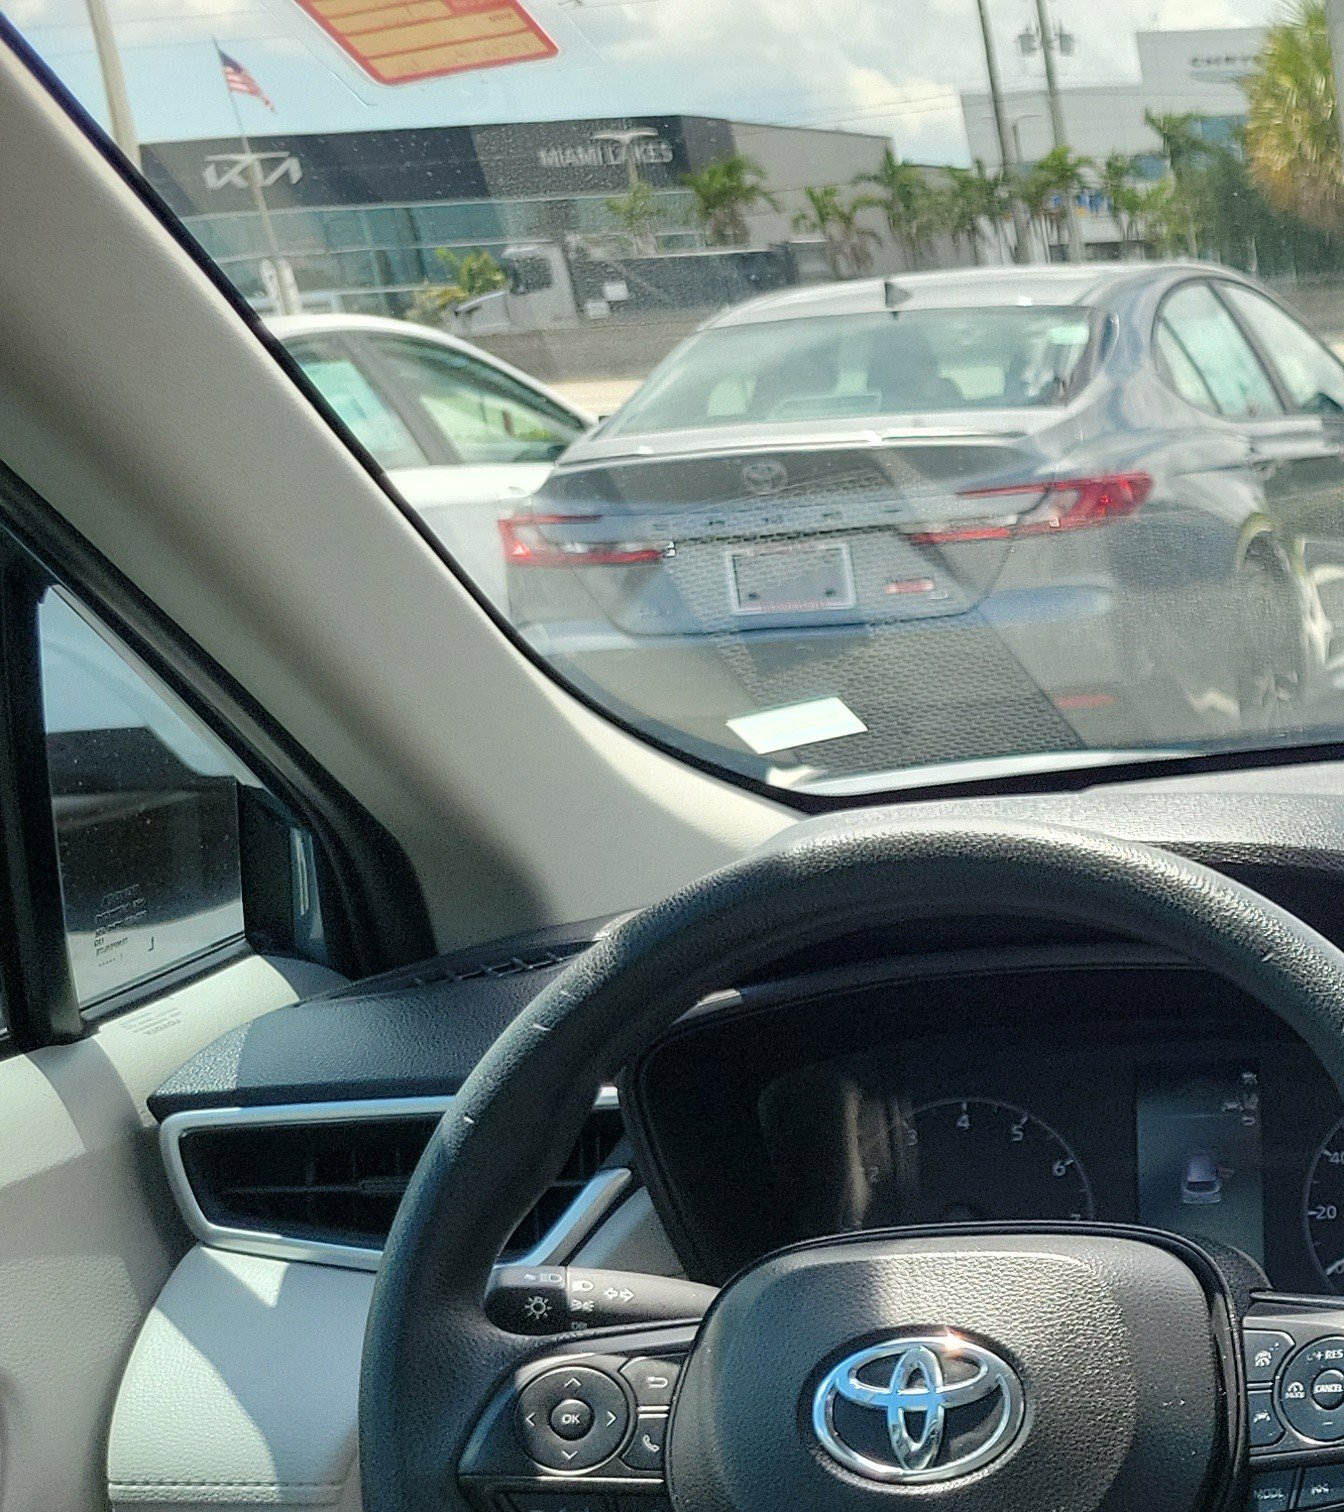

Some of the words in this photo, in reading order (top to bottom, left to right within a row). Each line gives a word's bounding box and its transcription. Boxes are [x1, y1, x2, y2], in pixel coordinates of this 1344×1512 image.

[1315, 1205, 1337, 1220] 20
[1325, 1349, 1344, 1360] RES
[1313, 1383, 1344, 1394] CANCEL
[561, 1413, 581, 1426] OK
